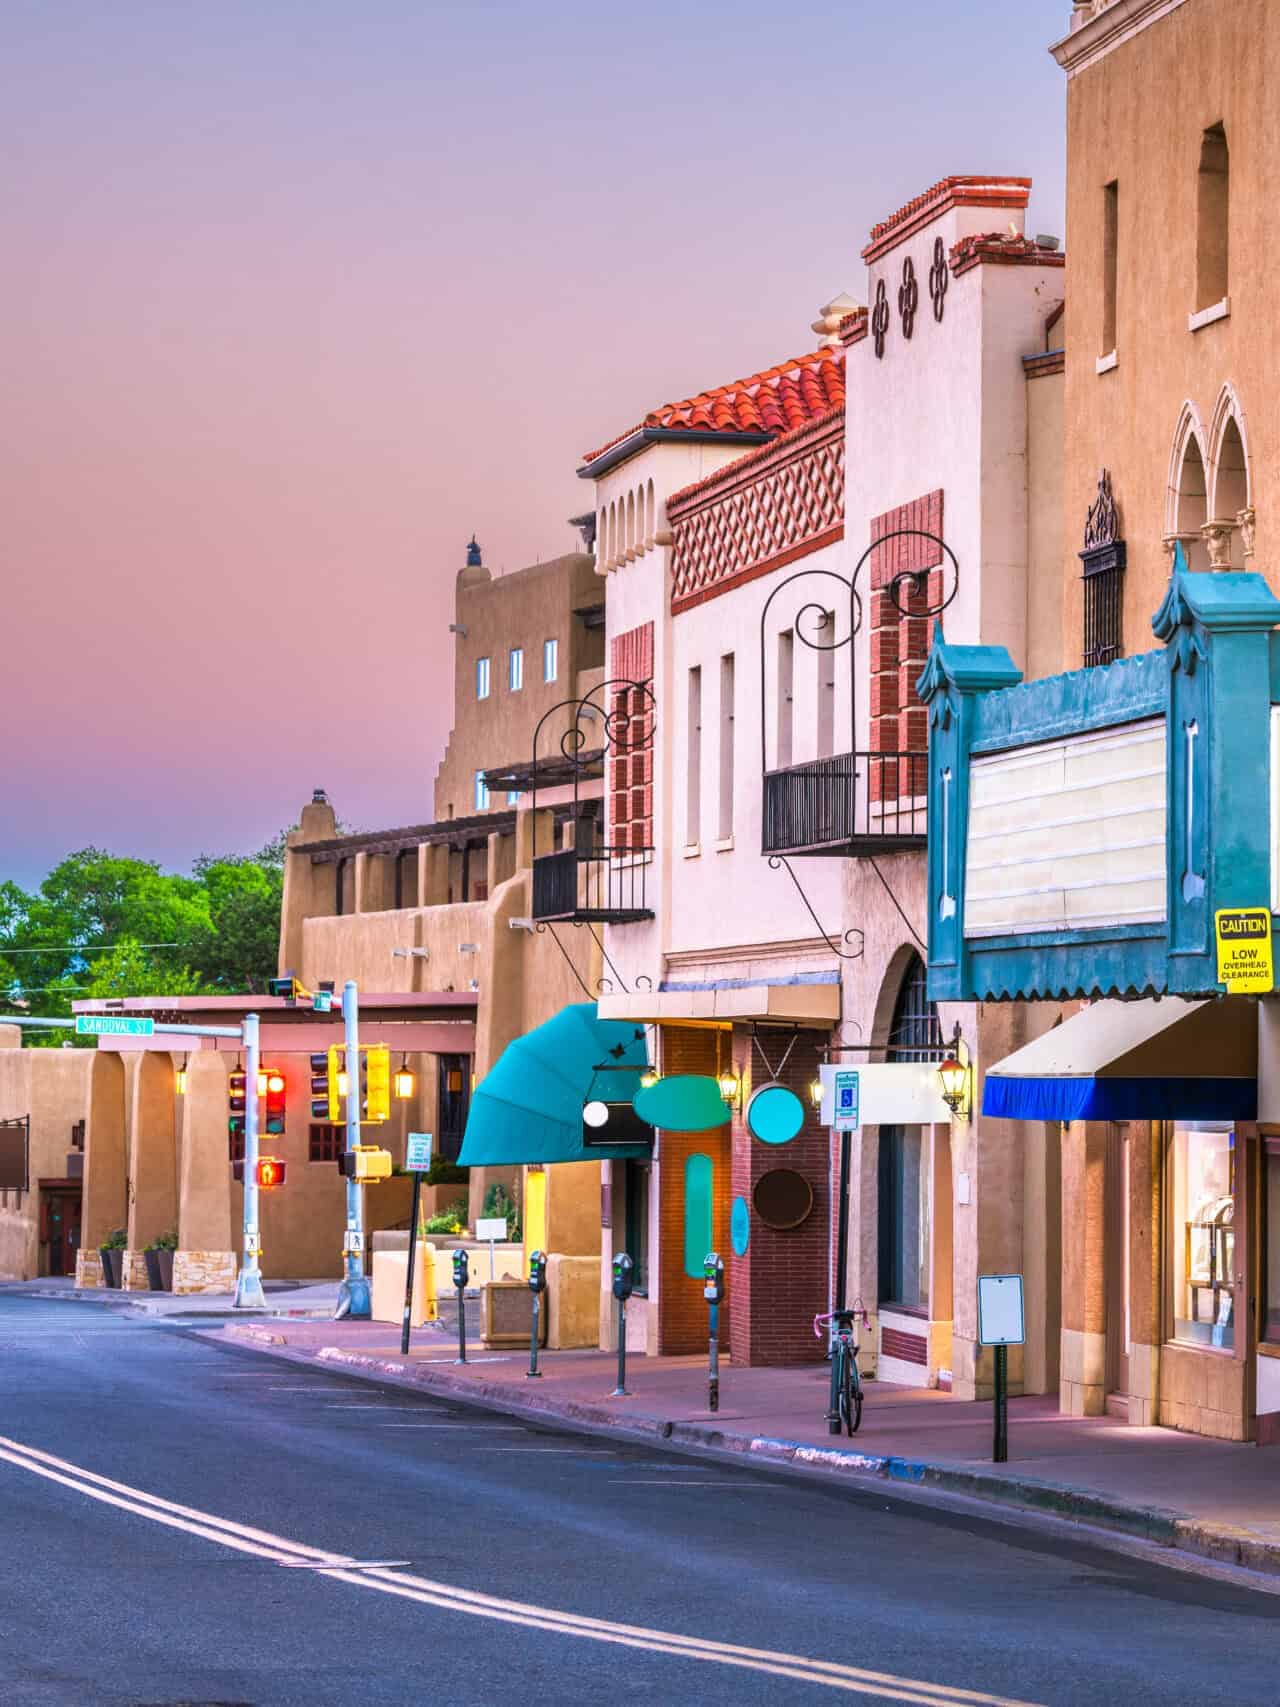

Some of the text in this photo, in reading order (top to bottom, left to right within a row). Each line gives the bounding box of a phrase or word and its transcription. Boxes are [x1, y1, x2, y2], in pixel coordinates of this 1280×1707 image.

[1220, 918, 1267, 933] CAUTION
[1232, 949, 1258, 960] LOW
[1223, 961, 1268, 970] OVERHEAD
[1222, 970, 1269, 979] CLEARANCE
[83, 1020, 131, 1033] SANDOVAL
